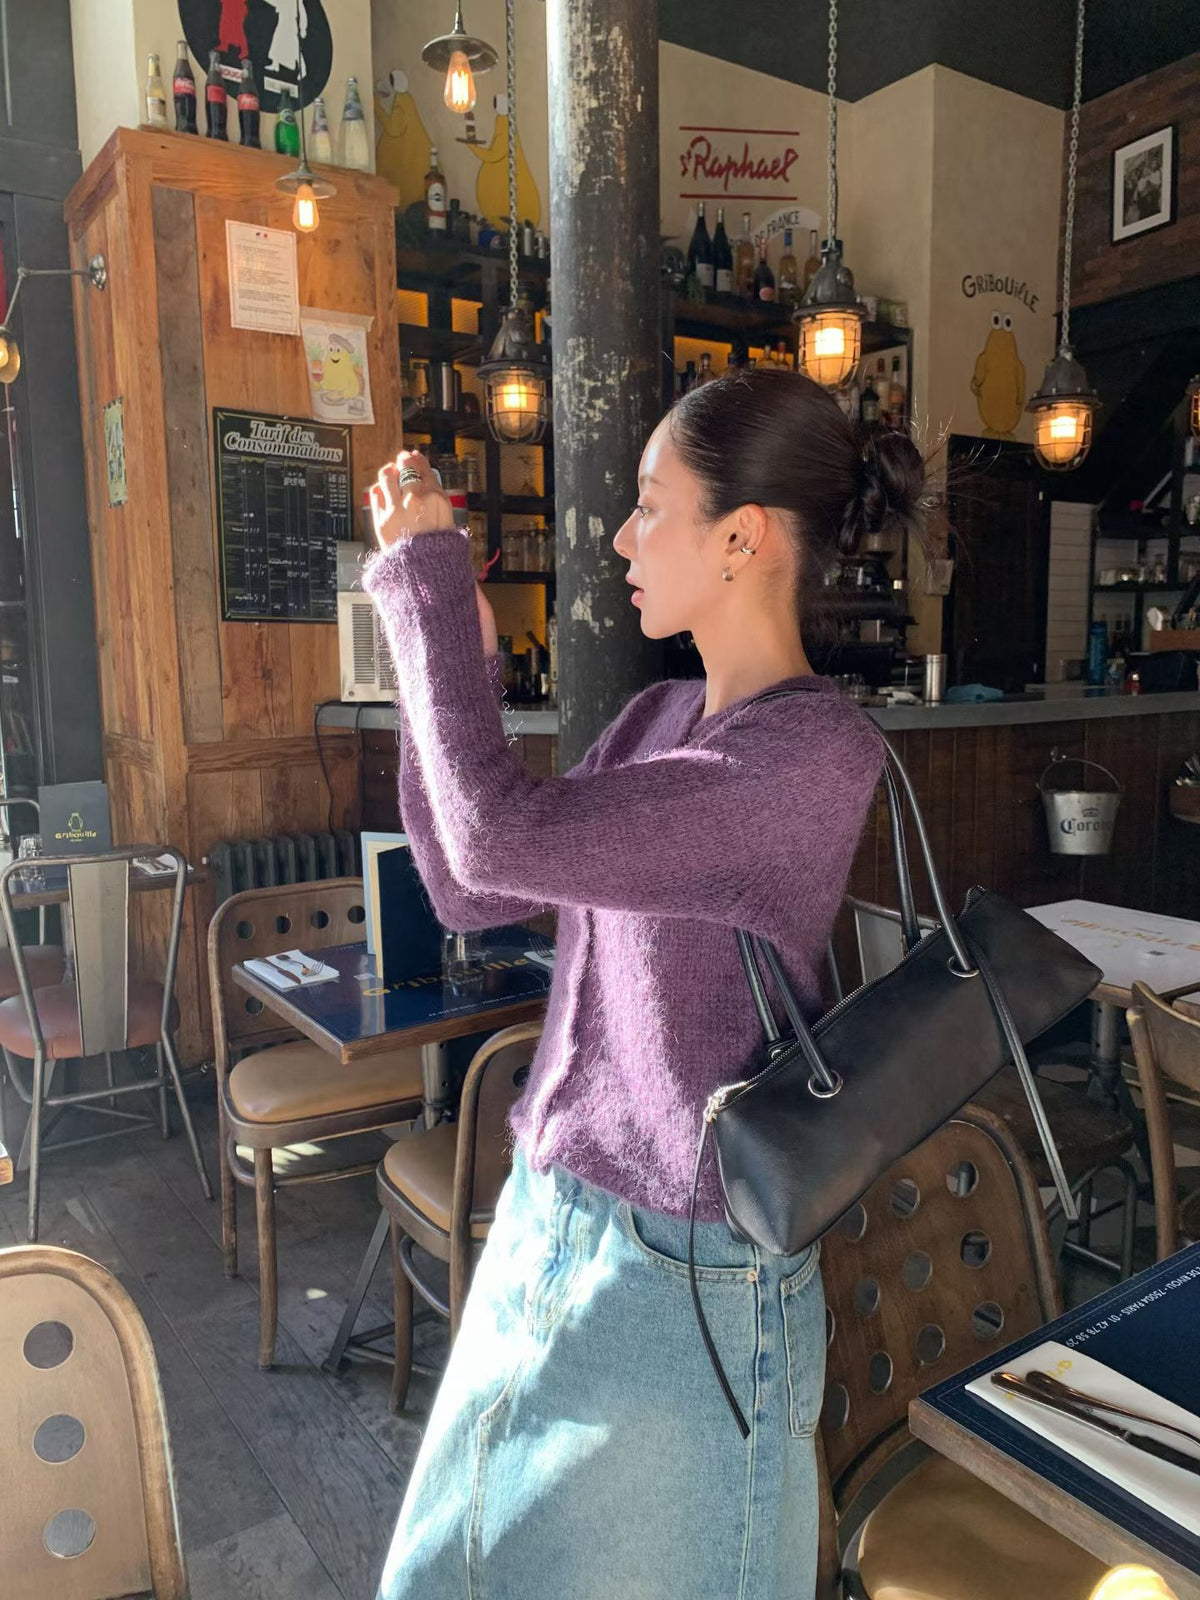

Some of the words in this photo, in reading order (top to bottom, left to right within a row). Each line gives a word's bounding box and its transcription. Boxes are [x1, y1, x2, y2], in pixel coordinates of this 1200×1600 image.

[766, 210, 800, 240] FRANCE
[250, 420, 292, 444] Tarif
[288, 426, 315, 446] des
[223, 431, 343, 462] Consommations
[1121, 1300, 1145, 1315] PARIS
[1107, 1314, 1121, 1323] 01
[1065, 1338, 1079, 1348] 29
